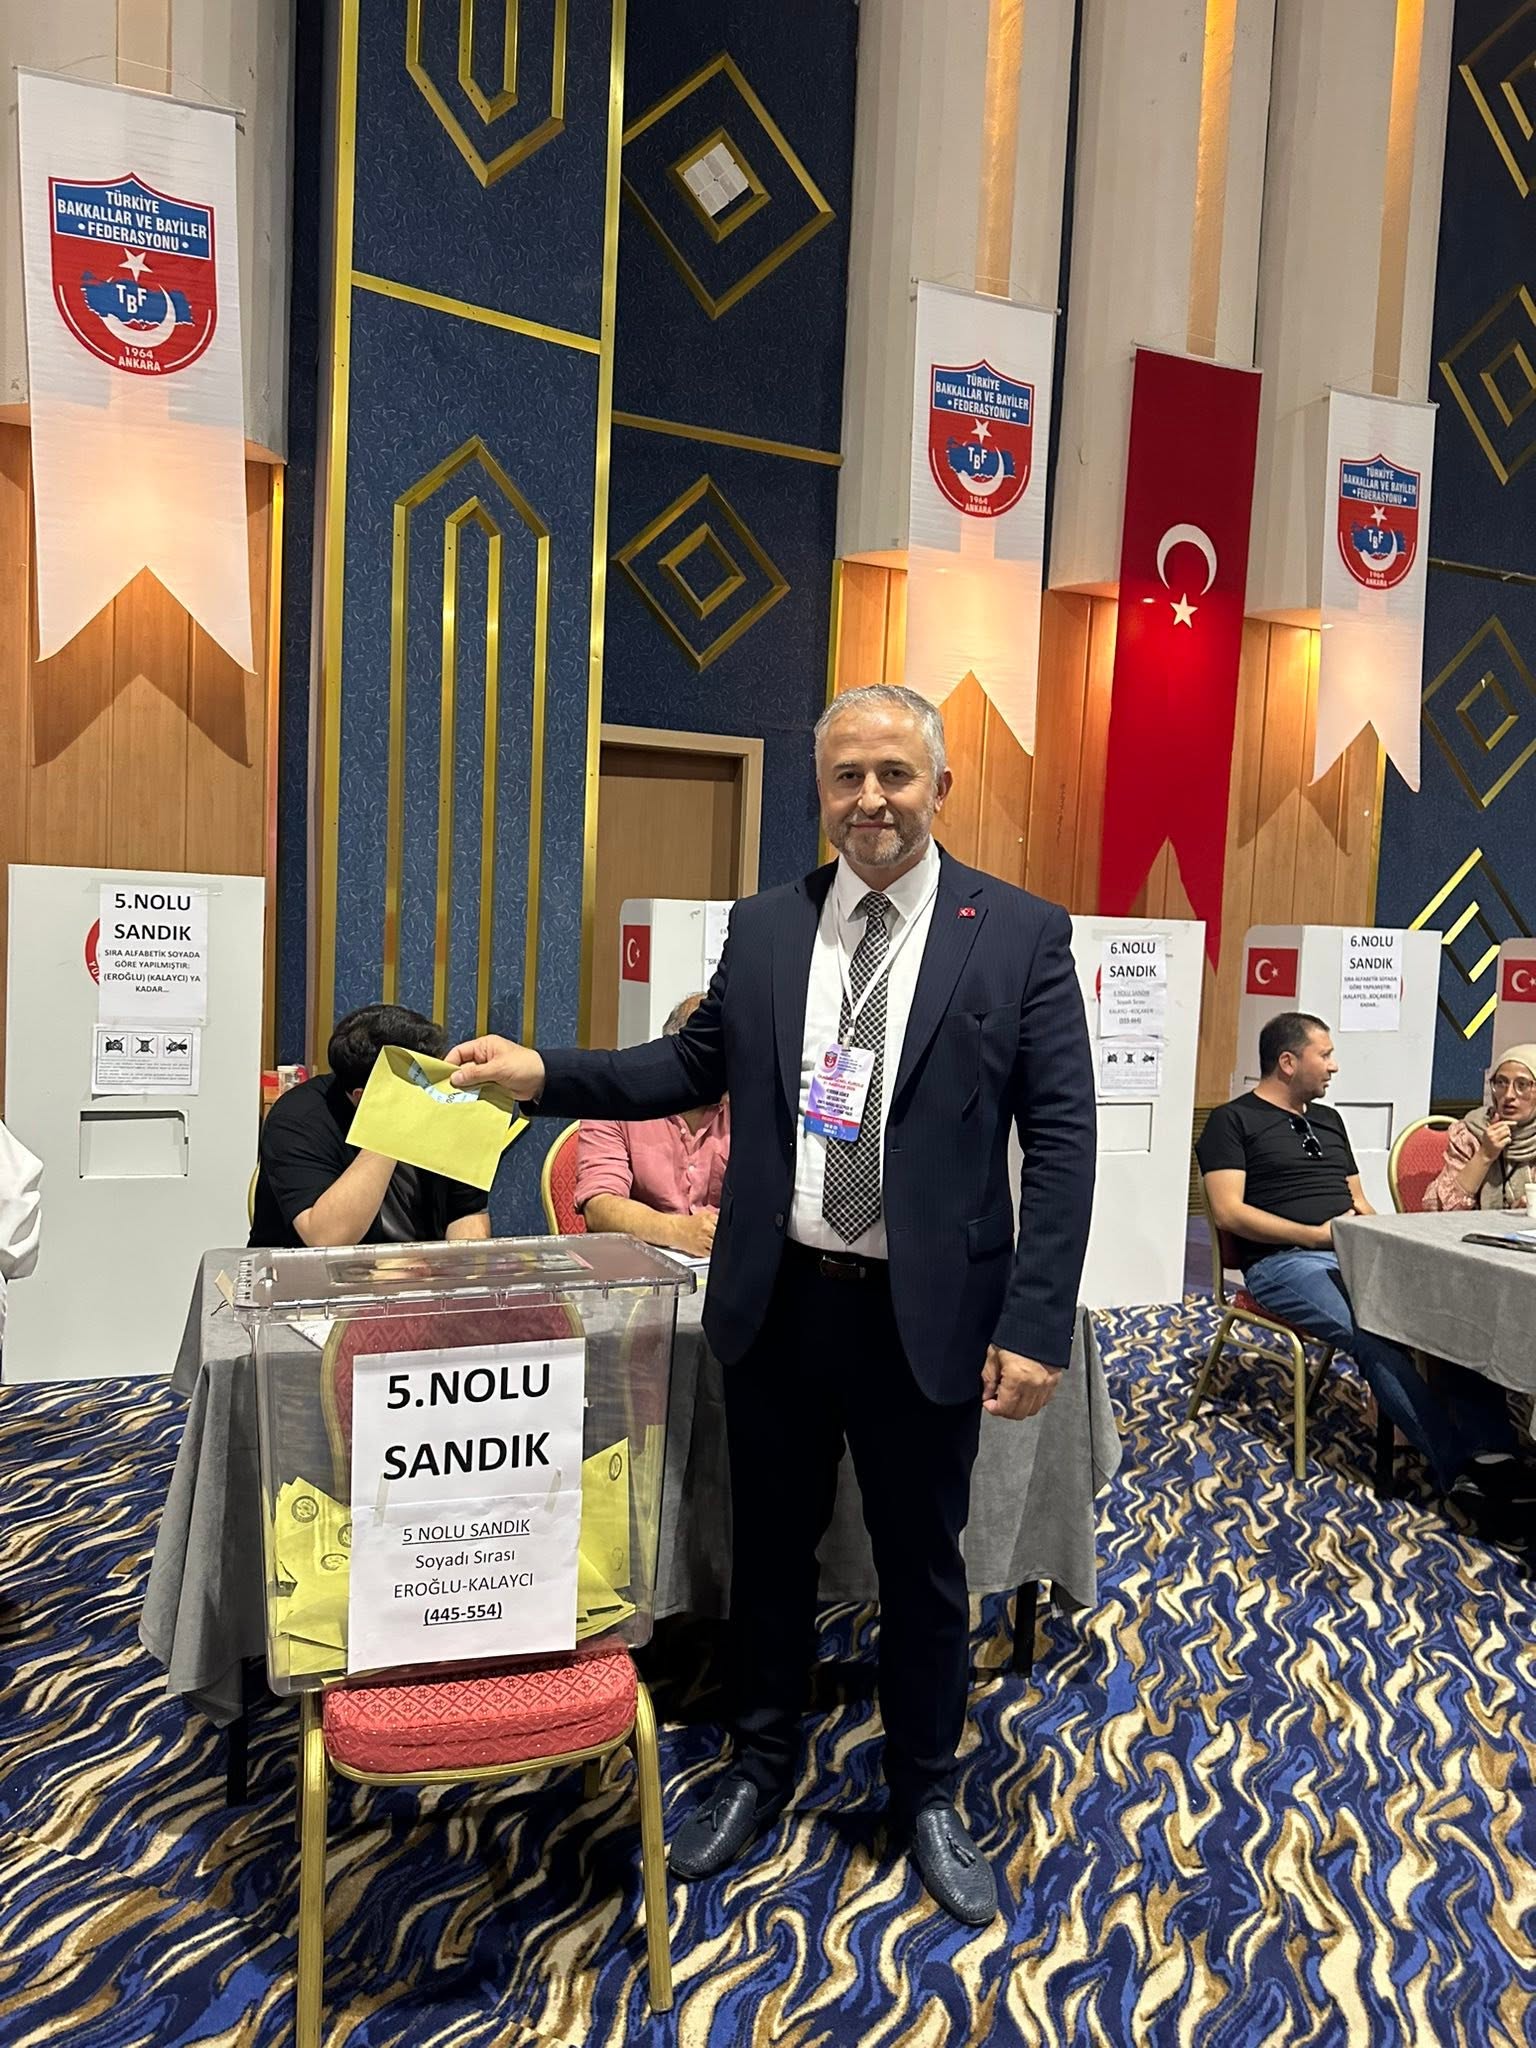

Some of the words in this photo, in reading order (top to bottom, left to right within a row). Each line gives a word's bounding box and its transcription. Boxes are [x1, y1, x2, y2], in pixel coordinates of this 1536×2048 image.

[106, 190, 159, 214] TÜRKİYE
[58, 199, 132, 226] BAKKALLAR
[136, 215, 153, 230] VE
[156, 217, 207, 239] BAYİLER
[88, 221, 179, 250] FEDERASYONU
[124, 347, 153, 359] 1964
[119, 356, 161, 372] ANKARA
[967, 374, 1000, 391] TÜRKİYE
[936, 381, 982, 400] BAKKALLAR
[984, 393, 994, 402] VE
[996, 394, 1029, 410] BAYİLER
[954, 398, 1010, 419] FEDERASYONU
[1381, 481, 1389, 491] VE
[970, 496, 988, 504] 1964
[965, 503, 992, 515] ANKARA
[114, 893, 191, 910] 5.NOLU
[114, 924, 192, 941] SANDIK
[1111, 942, 1156, 954] 6.NOLU
[1350, 936, 1393, 947] 6.NOLU
[124, 949, 166, 958] ALFABETİK
[115, 960, 137, 968] GÖRE
[139, 961, 190, 970] YAPILMIŞTIR:
[1110, 965, 1156, 977] SANDIK
[1349, 958, 1392, 969] SANDIK
[104, 972, 145, 982] (EROĞLU)
[147, 974, 189, 983] (KALAYCI)
[387, 1363, 549, 1409] 5.NOLU
[383, 1432, 549, 1480] SANDIK
[403, 1528, 412, 1542] 5
[419, 1525, 465, 1541] NOLU
[471, 1519, 530, 1538] SANDIK
[415, 1552, 469, 1570] Soyadı
[474, 1550, 515, 1564] Sırası
[395, 1573, 533, 1598] EROĞLU-KALAYCI
[423, 1602, 502, 1626] (445-554)
